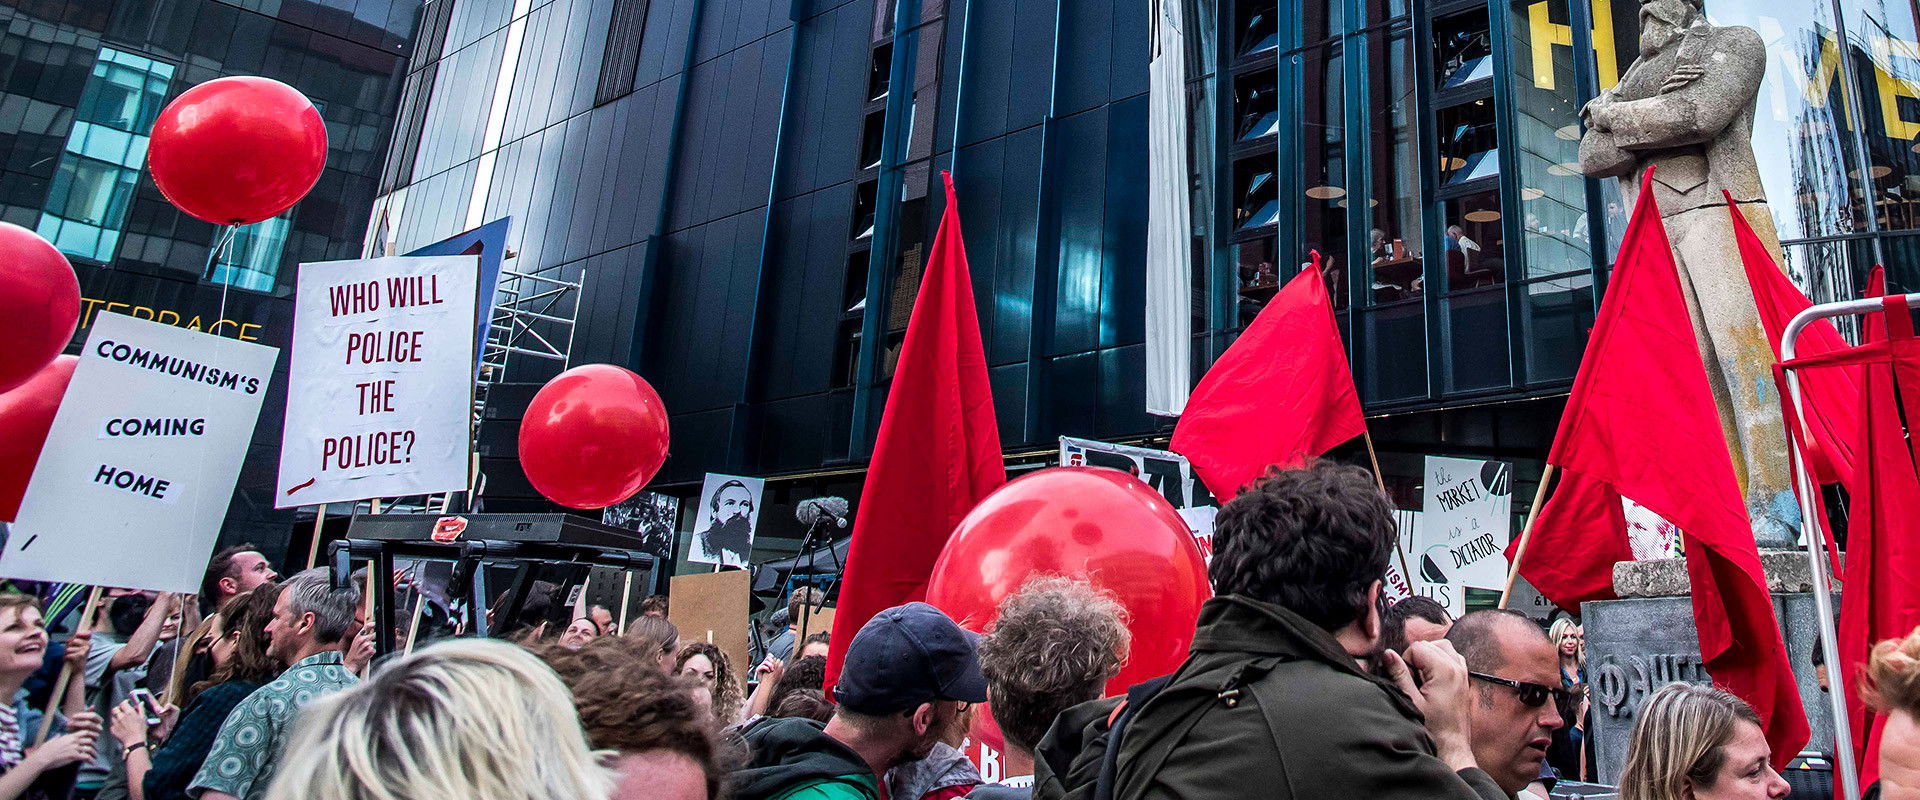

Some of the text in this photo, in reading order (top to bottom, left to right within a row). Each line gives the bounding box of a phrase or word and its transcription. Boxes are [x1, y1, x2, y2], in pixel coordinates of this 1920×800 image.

[329, 274, 444, 317] WHO WILL
[346, 331, 424, 365] POLICE
[97, 340, 260, 395] COMMUNISM'S
[356, 380, 396, 415] THE
[106, 418, 205, 437] COMING
[322, 430, 416, 471] POLICE?
[94, 464, 171, 499] HOME
[1434, 466, 1453, 487] the
[1436, 478, 1481, 512] MARKET
[1471, 517, 1480, 531] a
[1450, 532, 1501, 569] DICTATOR
